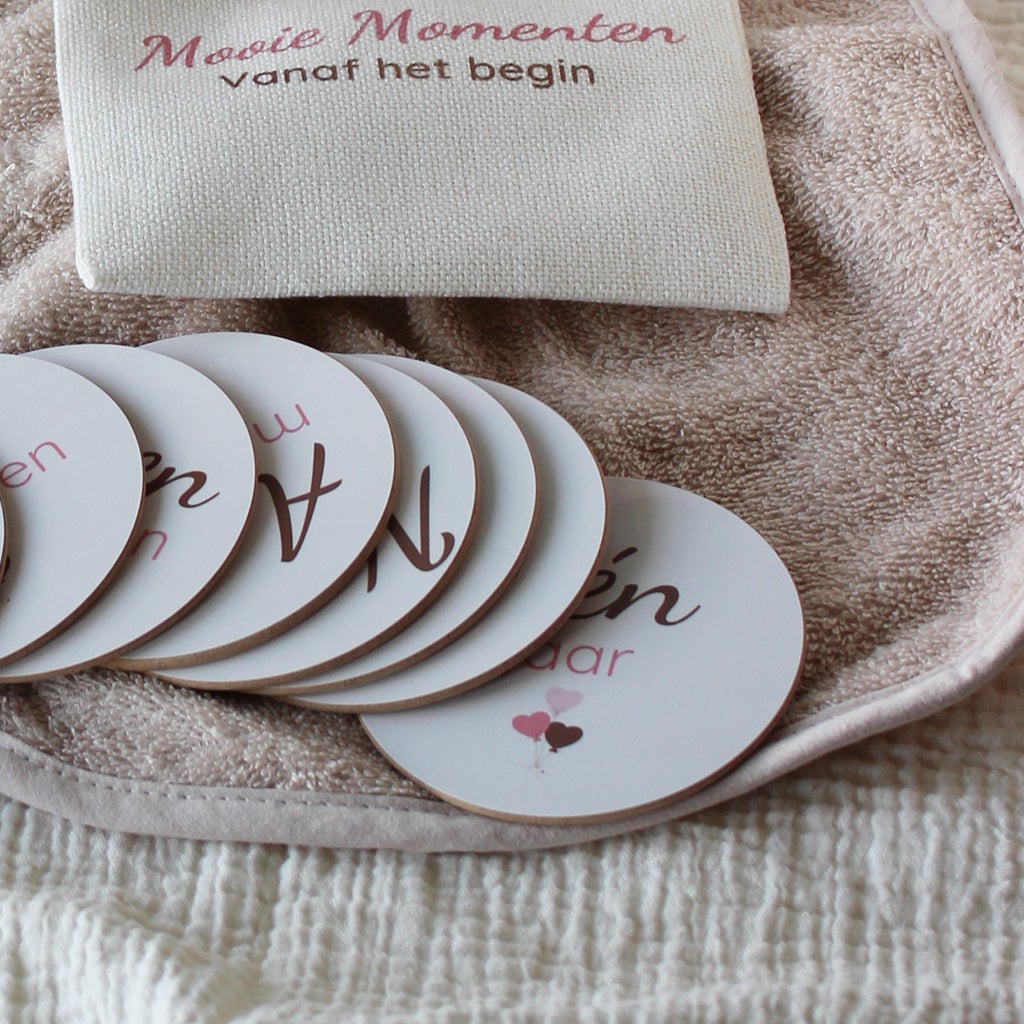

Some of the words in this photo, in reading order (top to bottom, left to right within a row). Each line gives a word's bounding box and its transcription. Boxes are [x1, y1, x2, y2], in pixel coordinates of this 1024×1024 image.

[134, 25, 326, 72] Mooie
[347, 8, 687, 46] Momenten
[220, 57, 360, 89] vanaf
[377, 55, 451, 80] het
[469, 57, 596, 89] begin
[570, 546, 701, 626] én
[524, 639, 635, 678] aar
